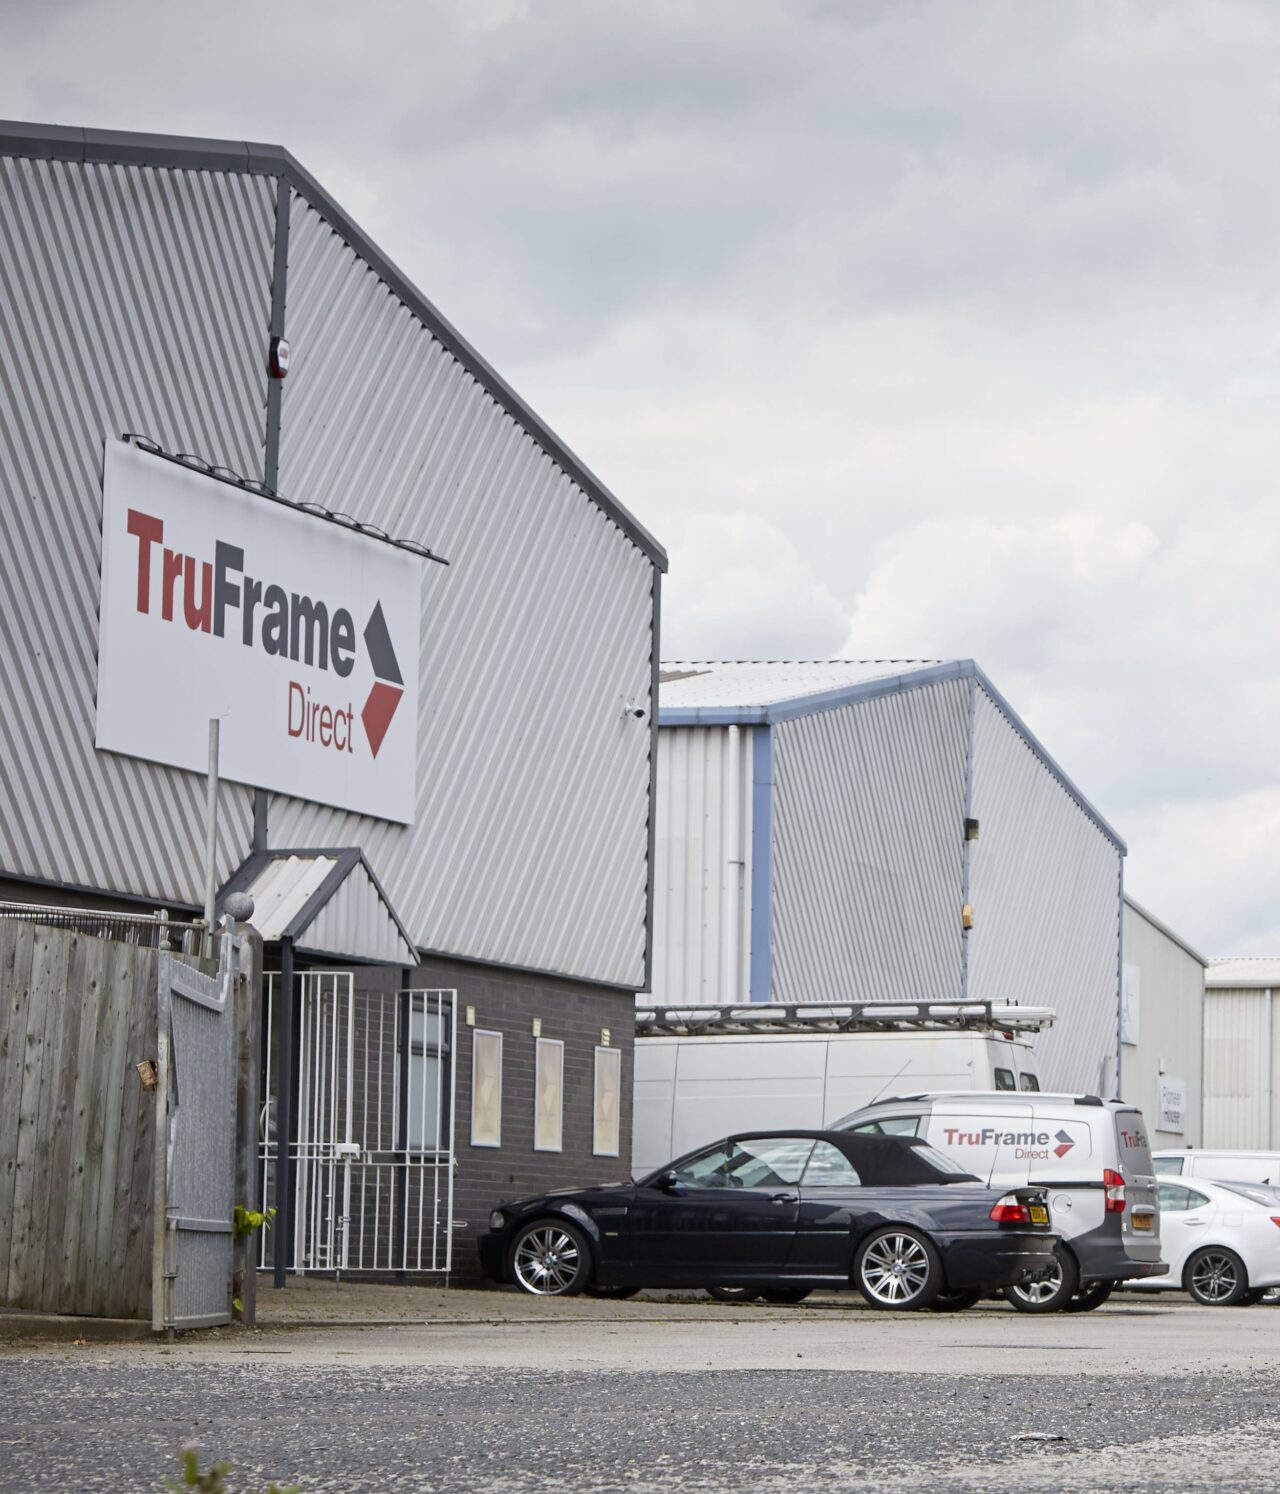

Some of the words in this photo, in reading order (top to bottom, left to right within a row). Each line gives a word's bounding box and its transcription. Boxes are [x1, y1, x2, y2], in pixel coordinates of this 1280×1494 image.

[127, 508, 356, 678] TruFrame
[288, 680, 354, 754] Direct
[943, 1128, 1050, 1146] TruFrame
[1014, 1148, 1049, 1159] Direct
